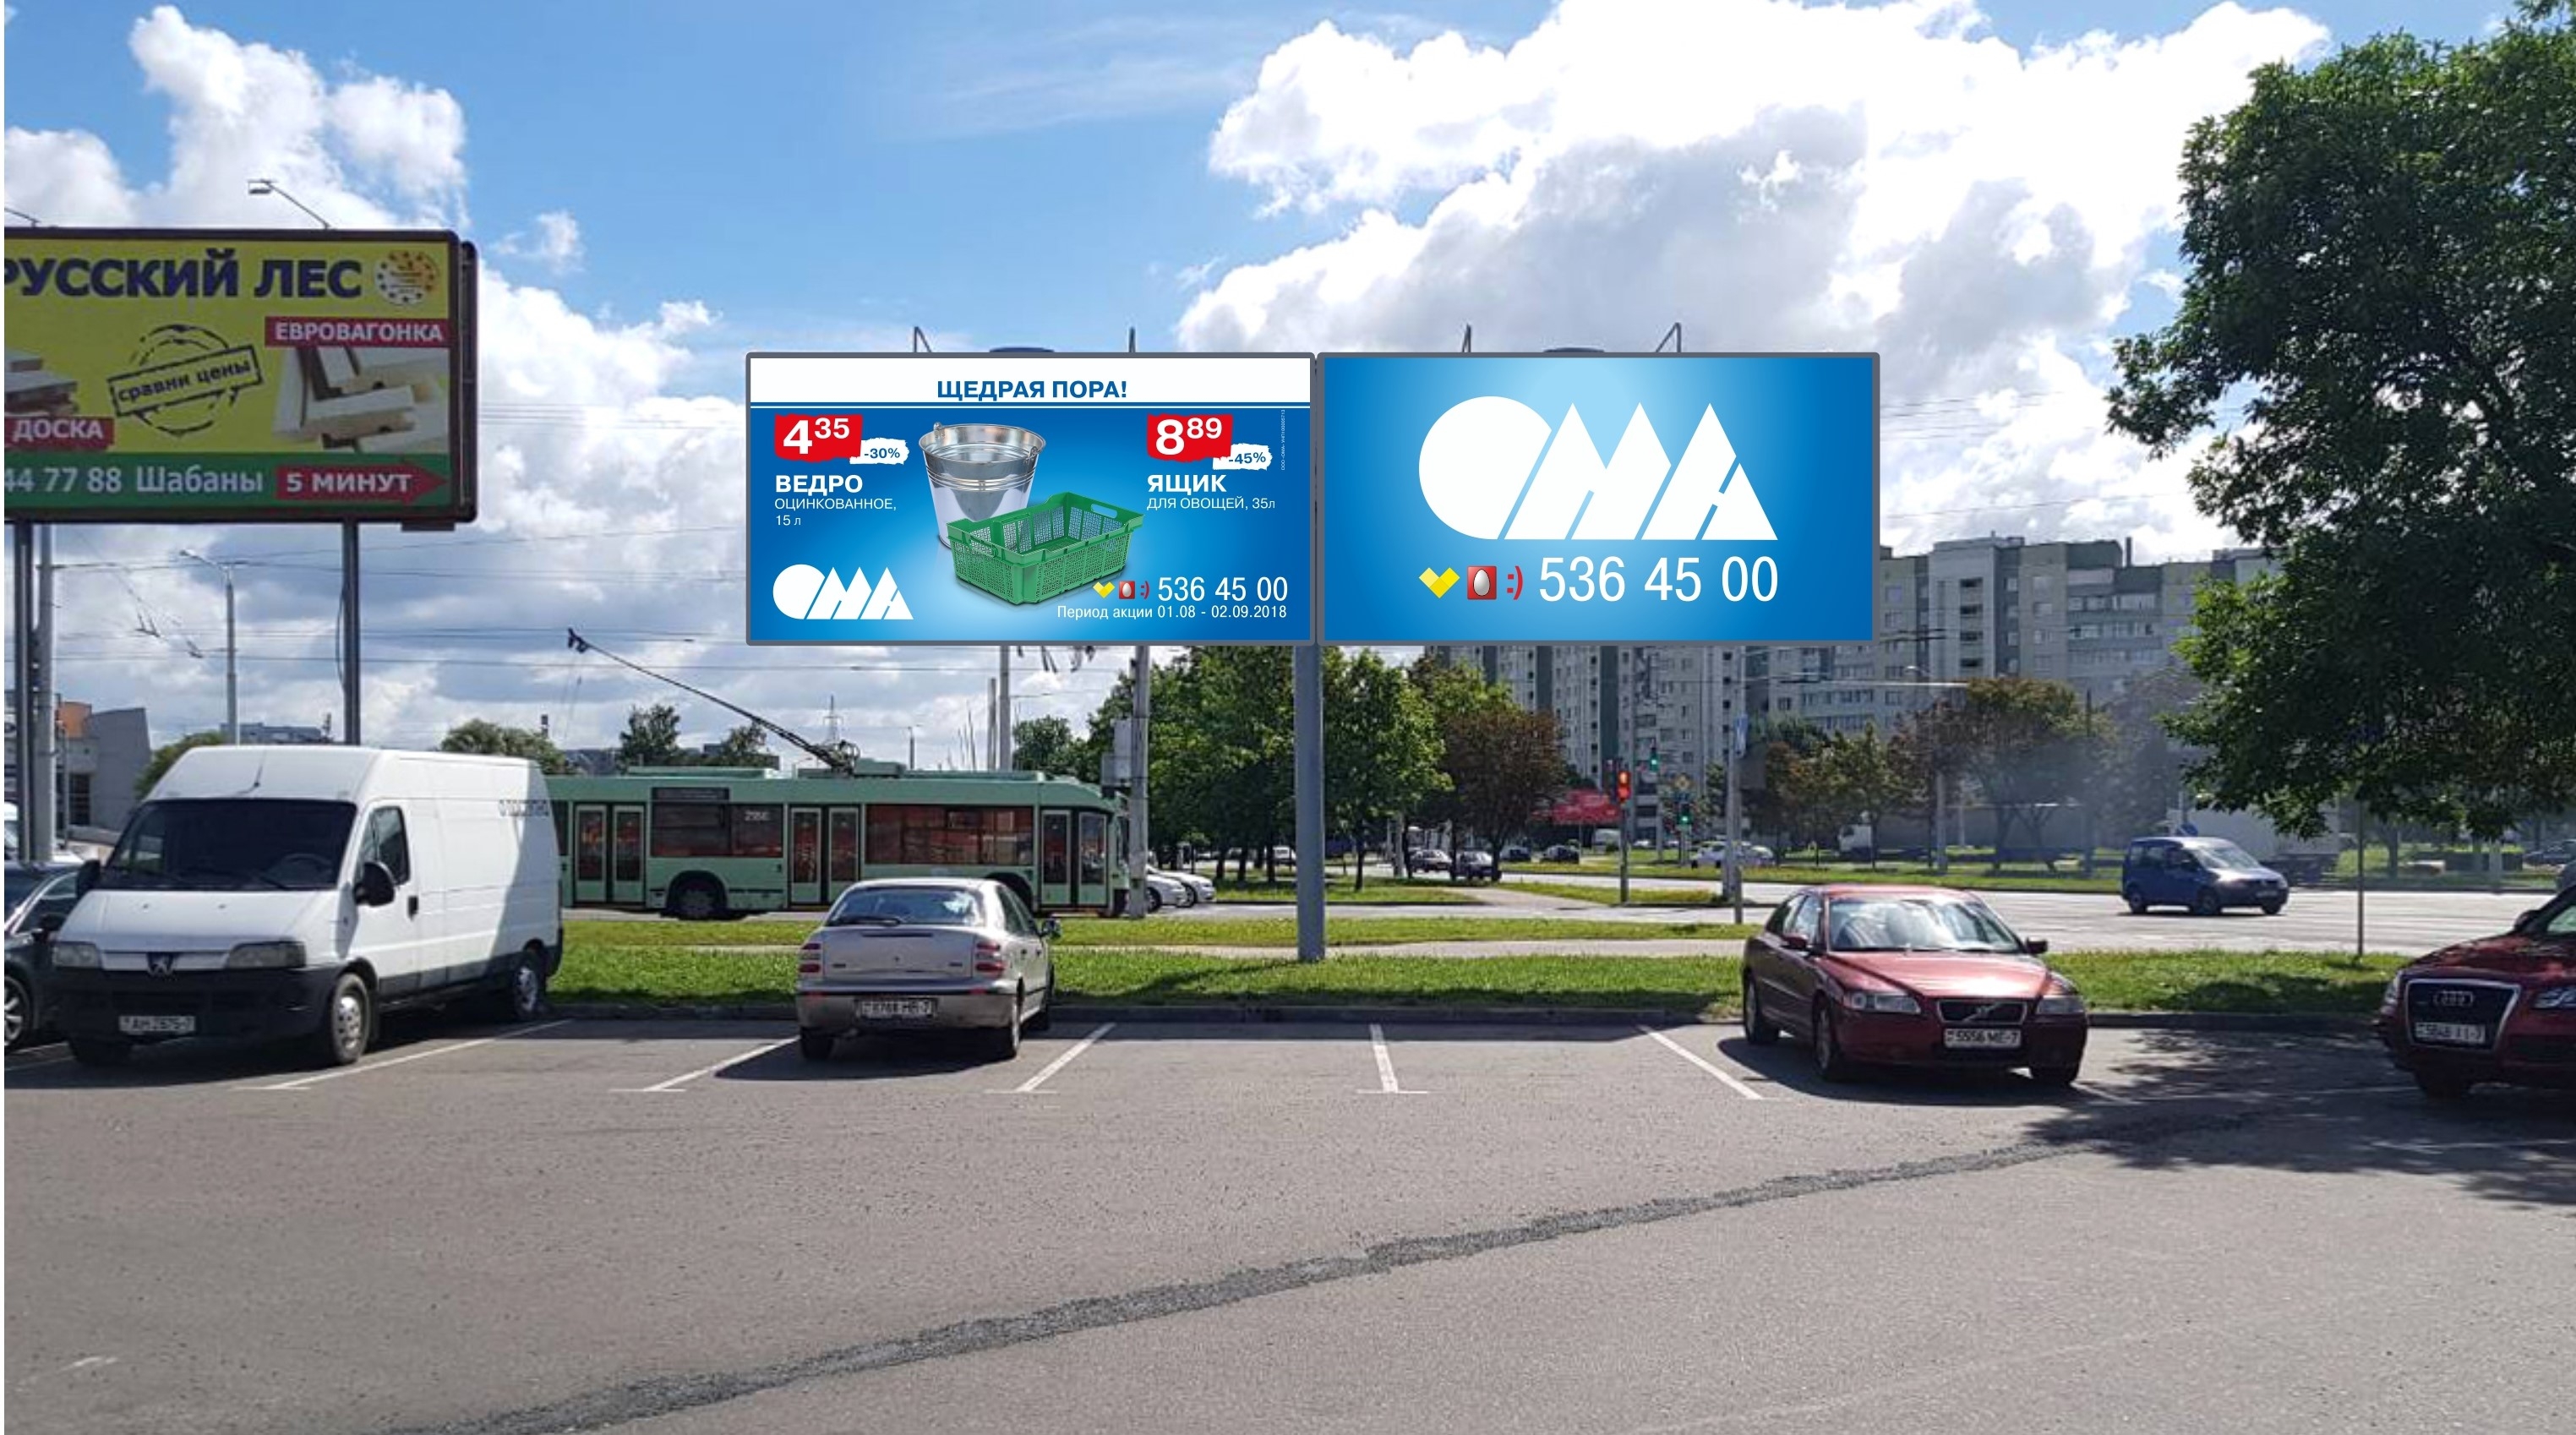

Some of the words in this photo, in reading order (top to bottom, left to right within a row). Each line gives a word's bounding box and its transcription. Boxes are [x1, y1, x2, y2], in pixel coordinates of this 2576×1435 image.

[254, 259, 362, 297] ЛЕС
[275, 322, 443, 341] ЕВРОВАГОНКА
[118, 374, 190, 402] сравни
[196, 361, 251, 384] цены
[937, 380, 1045, 401] ЩЕДРАЯ
[1052, 380, 1127, 399] ПОРА!
[12, 418, 104, 442] ДОСКА
[864, 447, 901, 459] -30%
[1228, 451, 1266, 465] -45%
[4, 467, 35, 493] 44
[42, 467, 78, 493] 77
[86, 466, 122, 493] 88
[136, 465, 264, 493] Шабаны
[287, 473, 303, 493] 5
[312, 473, 412, 493] МИНУТ
[775, 474, 864, 497] ВЕДРО
[1147, 473, 1227, 495] ЯЩИК
[774, 498, 897, 511] ОЦИНКОВАННОЕ,
[1146, 497, 1176, 511] ДЛЯ
[1180, 495, 1249, 511] ОВОЩЕЙ,
[775, 515, 791, 526] 15
[1158, 576, 1205, 602] 536
[1214, 576, 1247, 601] 45
[1257, 576, 1289, 602] 00
[1539, 556, 1626, 602] 536
[1644, 557, 1701, 602] 45
[1721, 556, 1778, 602] 00
[1056, 605, 1109, 621] Период
[1112, 608, 1153, 620] акции
[1157, 605, 1196, 618] 01.08
[1211, 605, 1287, 618] 02.09.2018
